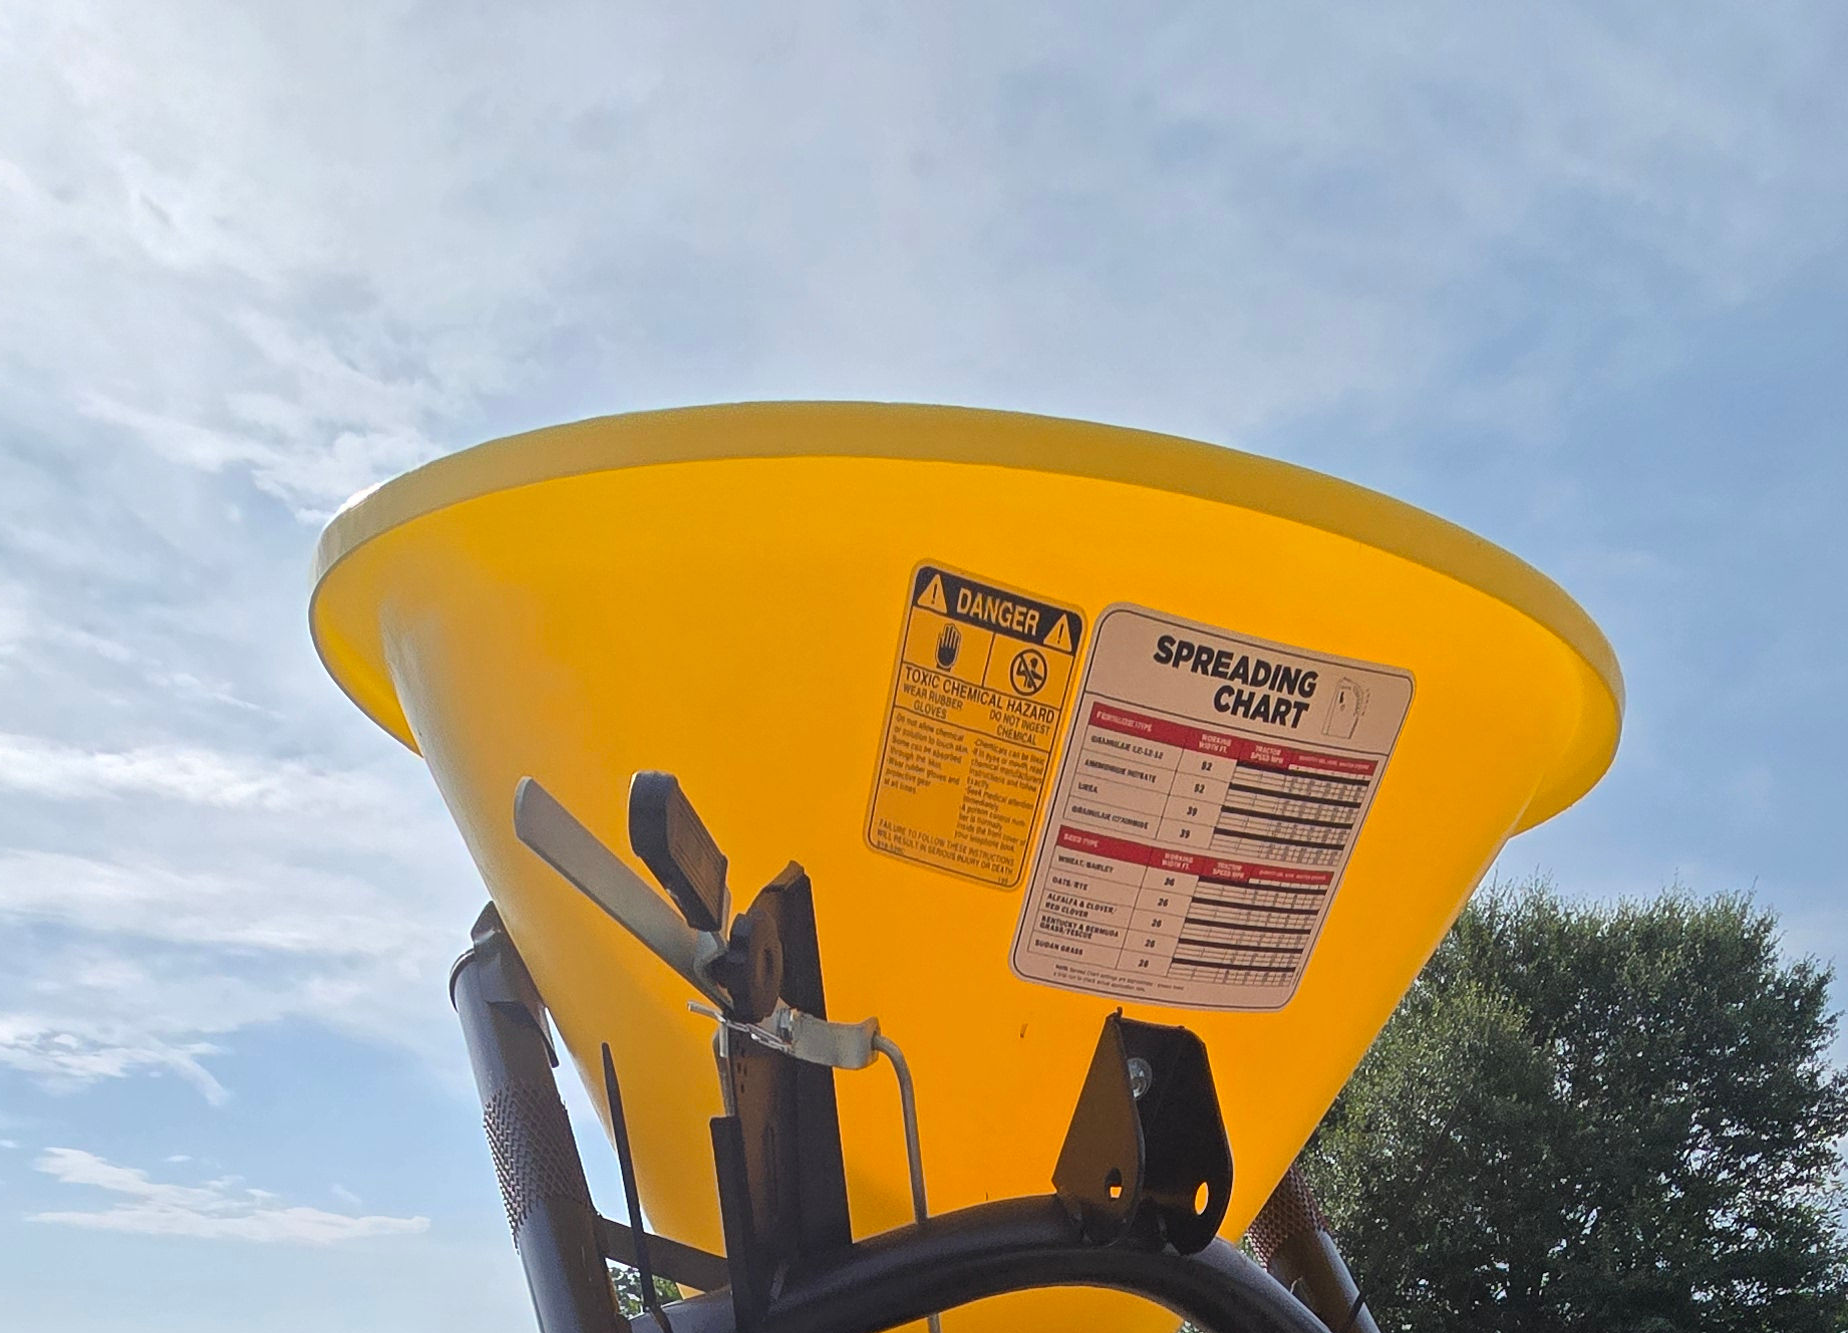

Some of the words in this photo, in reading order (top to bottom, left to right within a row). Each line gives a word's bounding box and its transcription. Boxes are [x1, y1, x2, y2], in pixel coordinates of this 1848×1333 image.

[957, 588, 1039, 635] DANGER
[1153, 635, 1319, 698] SPREADING
[903, 684, 927, 698] WEAR
[929, 688, 963, 710] RUBBER
[906, 667, 940, 688] TOXIC
[943, 679, 1002, 709] CHEMICAL
[1006, 700, 1055, 723] HAZARD
[1213, 685, 1310, 728] CHART
[914, 700, 947, 719] GLOVES
[989, 710, 1001, 722] DO
[1003, 713, 1020, 727] NOT
[1021, 718, 1050, 735] INGEST
[997, 725, 1037, 745] CHEMICAL
[917, 830, 945, 847] FOLLOW
[947, 839, 967, 851] THESE
[1045, 902, 1060, 913] RED
[1061, 906, 1089, 918] CLOVER
[1047, 893, 1078, 908] ALFALFA
[1041, 915, 1077, 930] KENTUCKY
[1084, 924, 1119, 938] BERMUDA
[1034, 939, 1059, 951] SUDAN
[1060, 944, 1083, 956] GRASS
